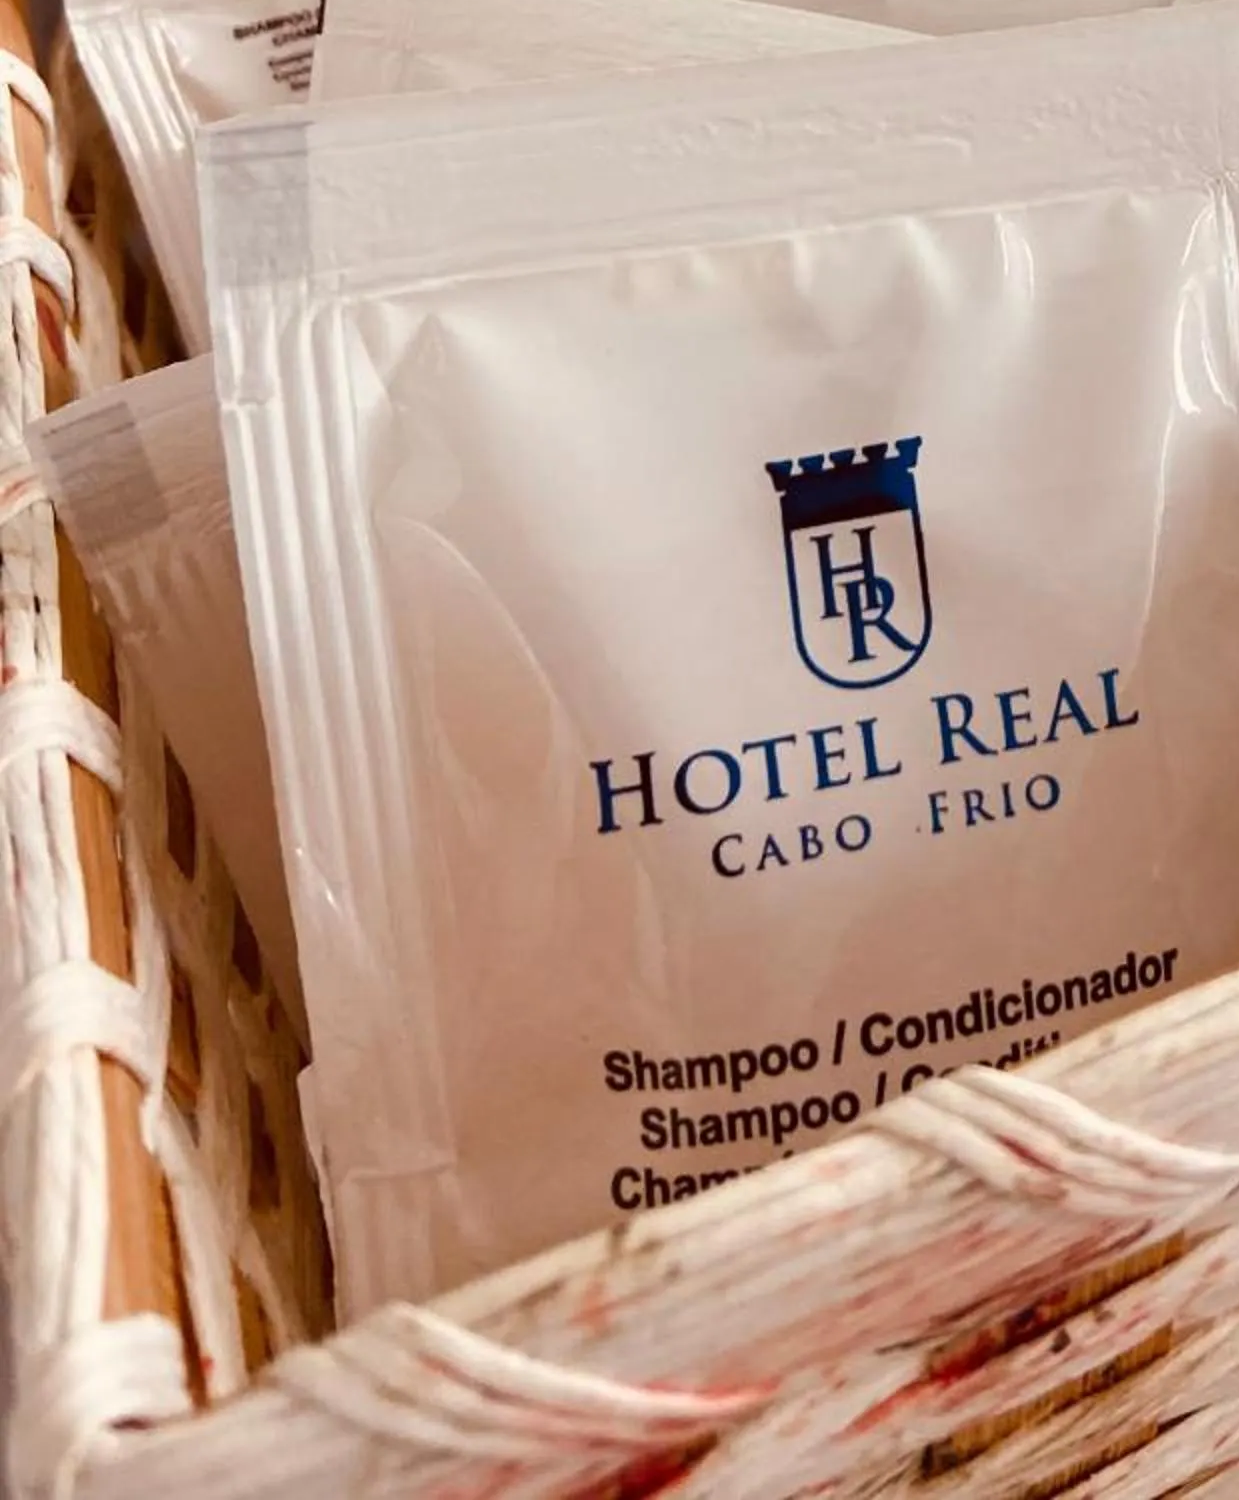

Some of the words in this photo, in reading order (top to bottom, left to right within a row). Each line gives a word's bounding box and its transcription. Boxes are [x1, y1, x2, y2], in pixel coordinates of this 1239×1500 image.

[589, 717, 901, 835] HOTEL
[931, 668, 1139, 765] REAL
[711, 814, 872, 878] CABO
[928, 773, 1062, 834] FRIO
[603, 1036, 820, 1093] Shampoo
[831, 1020, 847, 1066] /
[860, 948, 1179, 1057] Condicionador
[640, 1089, 861, 1150] Shampoo
